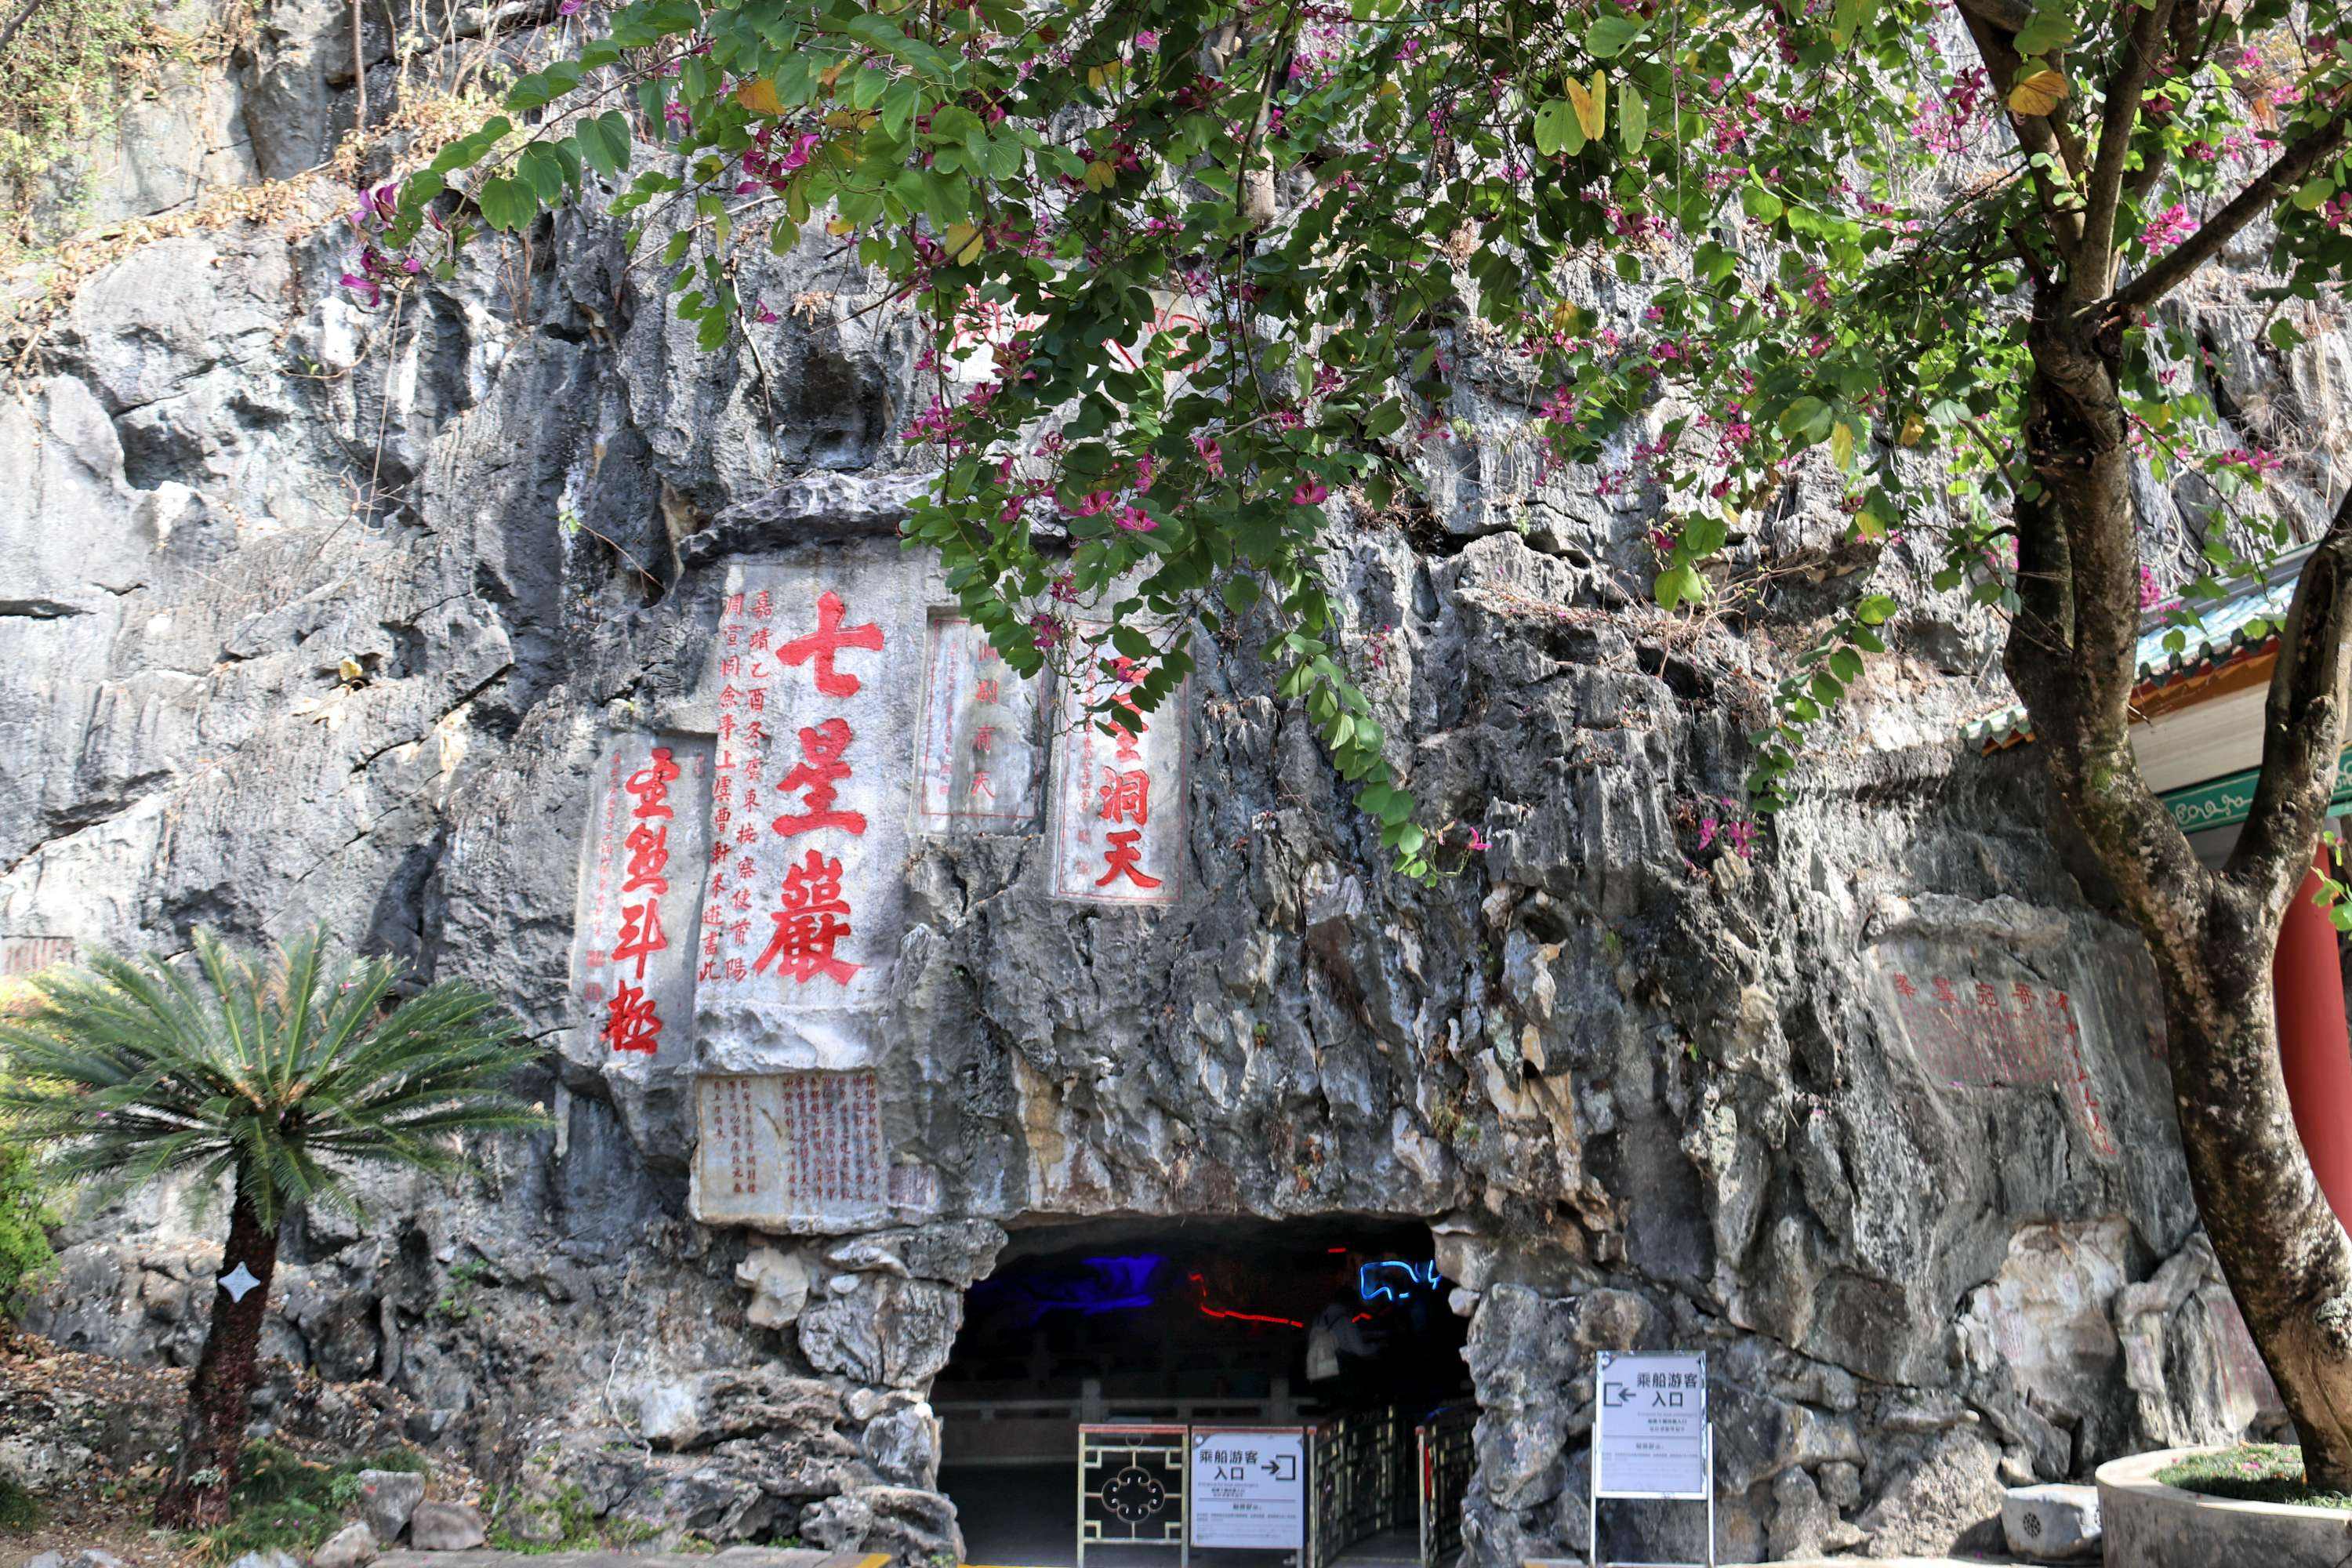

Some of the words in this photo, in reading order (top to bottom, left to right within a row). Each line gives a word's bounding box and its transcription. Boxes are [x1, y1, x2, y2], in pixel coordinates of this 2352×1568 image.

[1637, 1372, 1698, 1388] 乘船游客
[1652, 1391, 1683, 1407] 入口
[1200, 1450, 1258, 1465] 乘船游客
[1214, 1466, 1244, 1481] 入口
